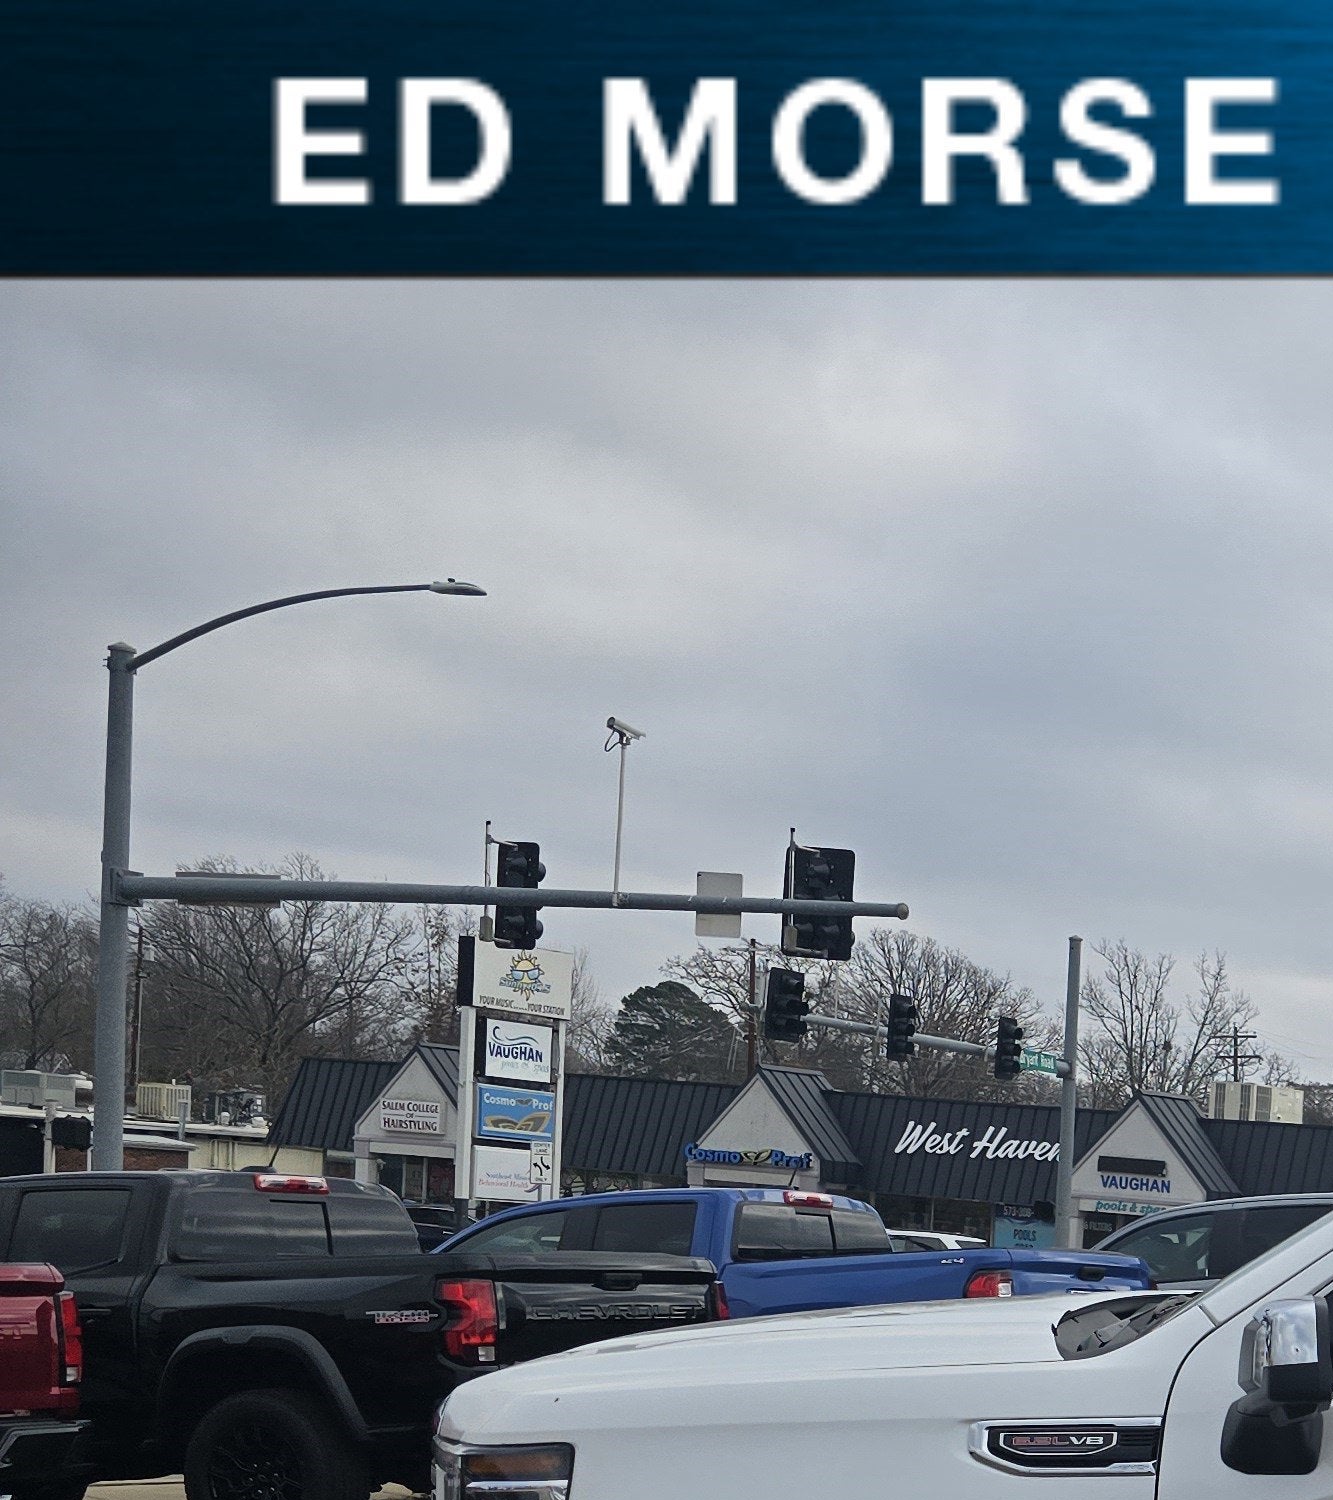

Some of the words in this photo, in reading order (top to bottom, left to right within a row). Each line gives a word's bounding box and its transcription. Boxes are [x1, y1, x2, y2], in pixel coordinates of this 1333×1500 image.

[480, 995, 495, 1005] YOUR
[527, 1003, 542, 1013] YOUR
[543, 1005, 565, 1016] STATION
[488, 1042, 543, 1063] VAUGHAN
[382, 1100, 405, 1111] SALEM
[407, 1102, 439, 1114] COLLEGE
[483, 1092, 516, 1106] Cosmo
[532, 1099, 553, 1111] Prof
[383, 1117, 437, 1131] HAIRSTYLING
[894, 1120, 970, 1155] West
[970, 1125, 1061, 1162] Haven
[685, 1143, 742, 1165] Cosmo
[770, 1149, 813, 1169] Prof
[1101, 1174, 1171, 1194] VAUGHAN
[1096, 1201, 1128, 1213] pools
[1129, 1202, 1137, 1213] &
[1013, 1228, 1037, 1242] POOLS
[526, 1303, 707, 1321] CHEVROLET
